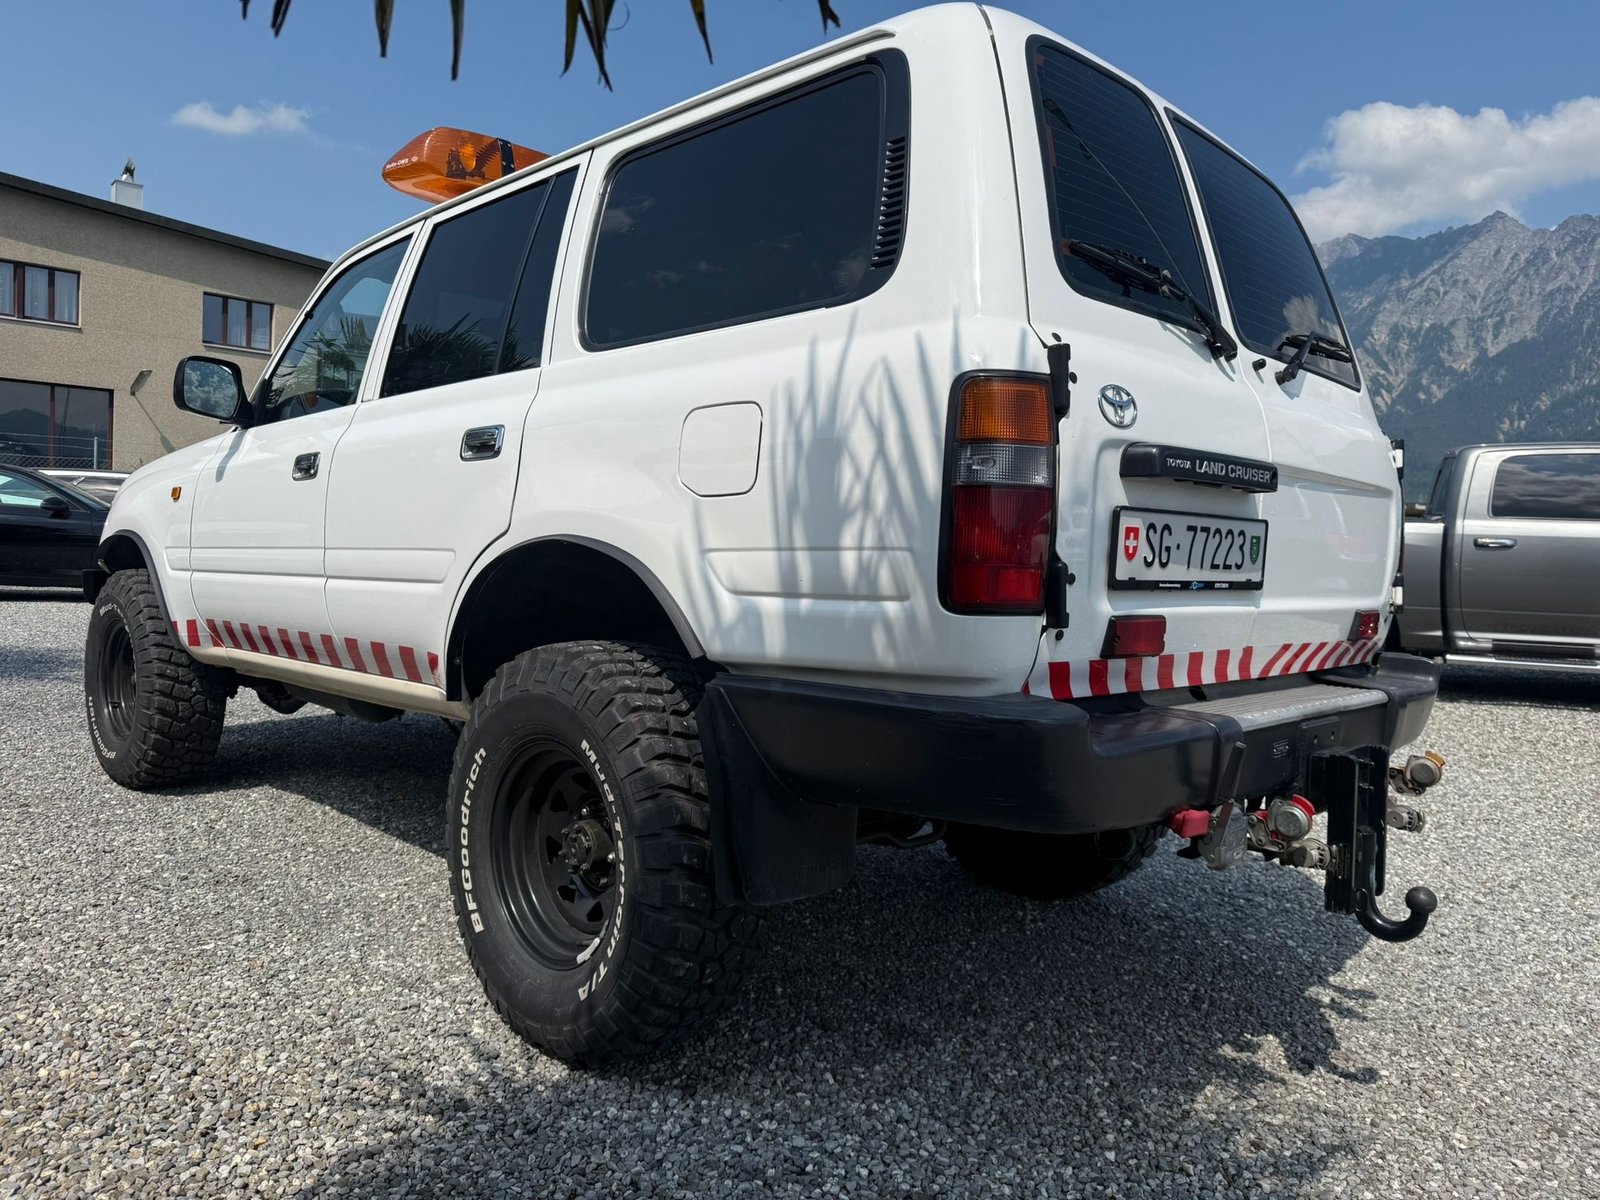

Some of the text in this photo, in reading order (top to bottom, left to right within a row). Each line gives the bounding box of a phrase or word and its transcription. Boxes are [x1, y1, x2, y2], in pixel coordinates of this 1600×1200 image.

[1166, 457, 1271, 483] TOYOTA LAND CRUISER
[460, 748, 487, 934] BFGoodrich
[577, 739, 625, 1001] Mud-Terrain T/A
